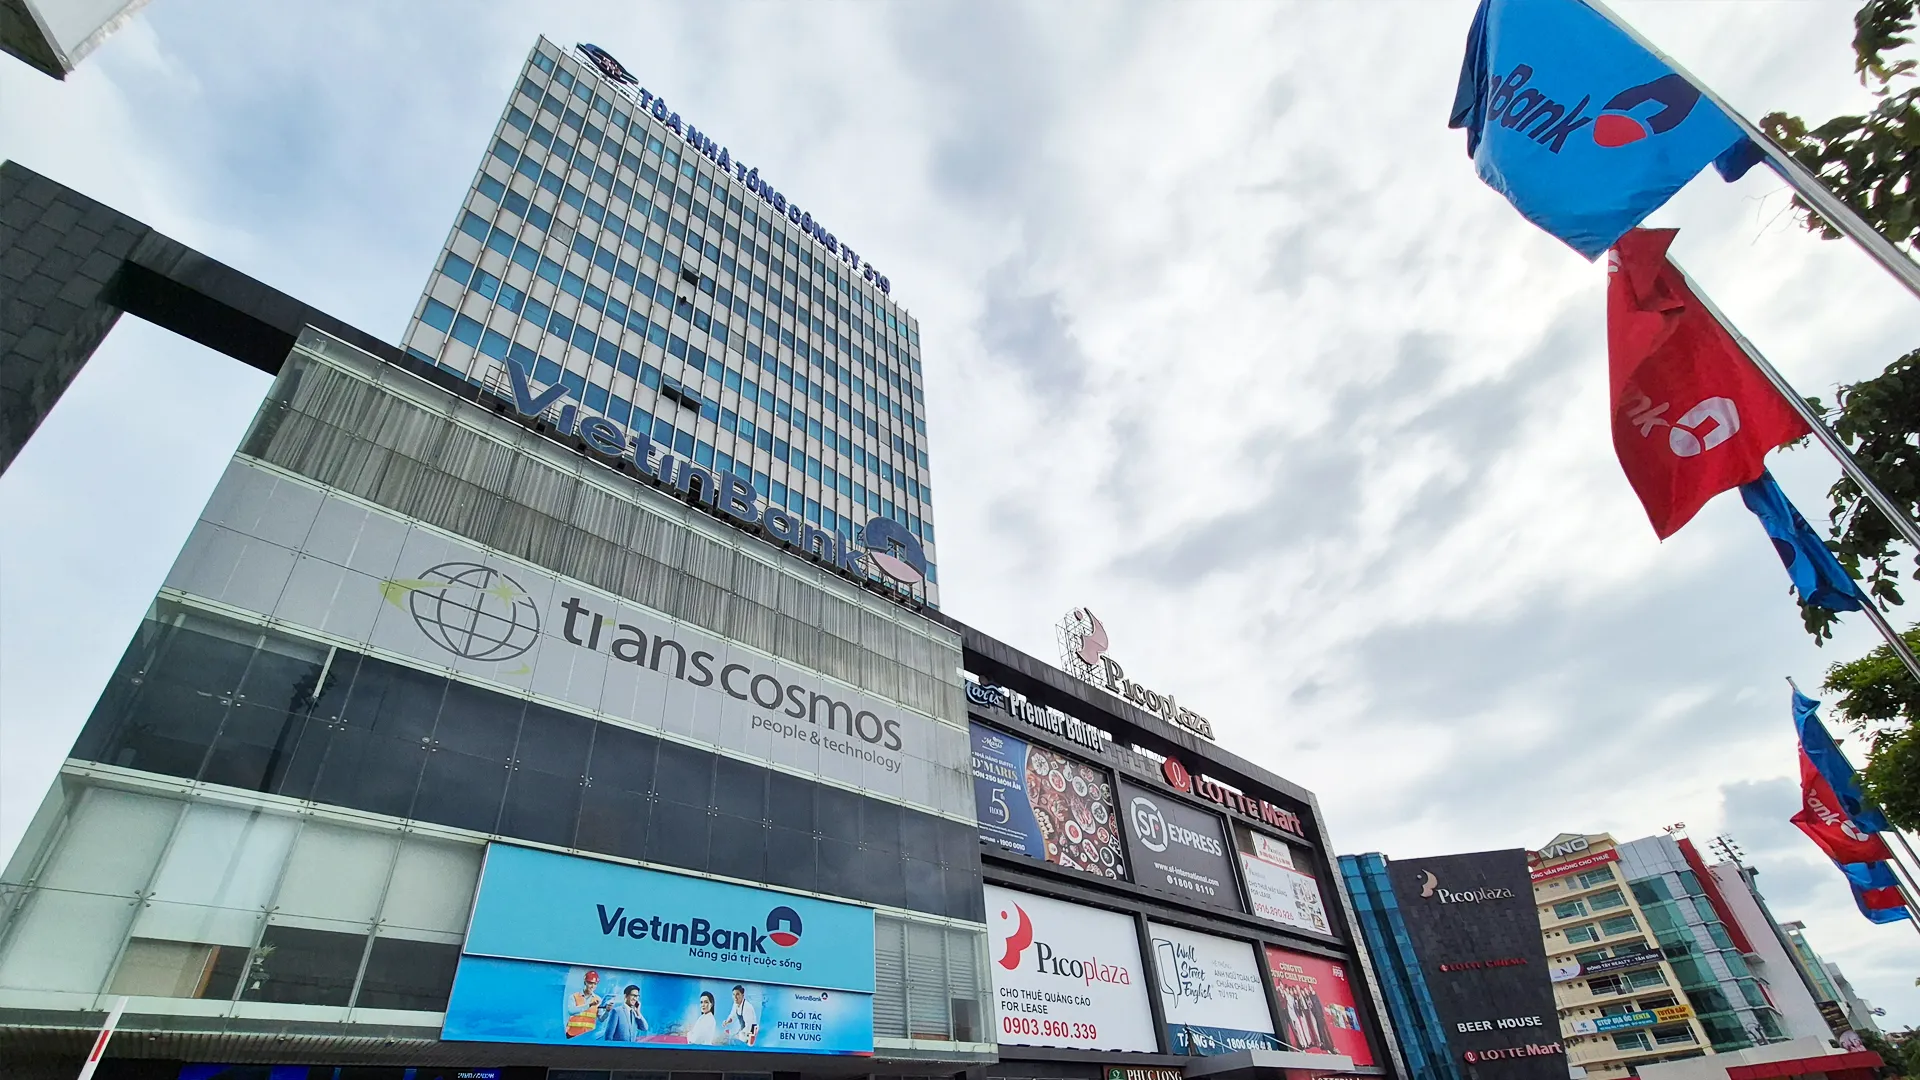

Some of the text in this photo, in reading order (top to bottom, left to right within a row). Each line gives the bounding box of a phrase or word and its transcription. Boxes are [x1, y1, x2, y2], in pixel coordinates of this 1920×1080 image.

[640, 87, 682, 136] TÒA
[788, 203, 838, 255] CÔNG
[841, 243, 860, 270] TY
[864, 262, 890, 294] 319
[504, 354, 867, 580] VietinBank
[561, 597, 903, 751] transcosmos
[1100, 654, 1215, 741] Picoplaza
[1008, 689, 1065, 736] Premier
[751, 715, 902, 775] people & technology
[992, 787, 1010, 824] 5
[1192, 775, 1305, 838] LOTTE Mart
[1167, 823, 1222, 857] EXPRESS
[1541, 837, 1588, 858] VNO
[1557, 862, 1578, 874] PHÒNG
[1578, 858, 1592, 867] CHO
[1593, 852, 1610, 864] THUÊ
[1437, 887, 1513, 904] Picoplaza
[596, 904, 768, 954] VietinBank
[689, 948, 802, 971] Nâng giá trị cuộc sống
[1034, 941, 1130, 987] Picoplaza
[1176, 943, 1197, 963] Wall
[1485, 958, 1528, 968] CINEMA
[1180, 961, 1206, 982] Street
[795, 993, 822, 1002] VietinBank
[1000, 987, 1019, 999] CHO
[1182, 981, 1213, 1004] English
[1001, 1001, 1049, 1015] FOR LEASE
[1003, 1016, 1097, 1040] 0903.960.339
[1457, 1016, 1542, 1032] BEER HOUSE
[1480, 1042, 1563, 1060] LOTTE Mart
